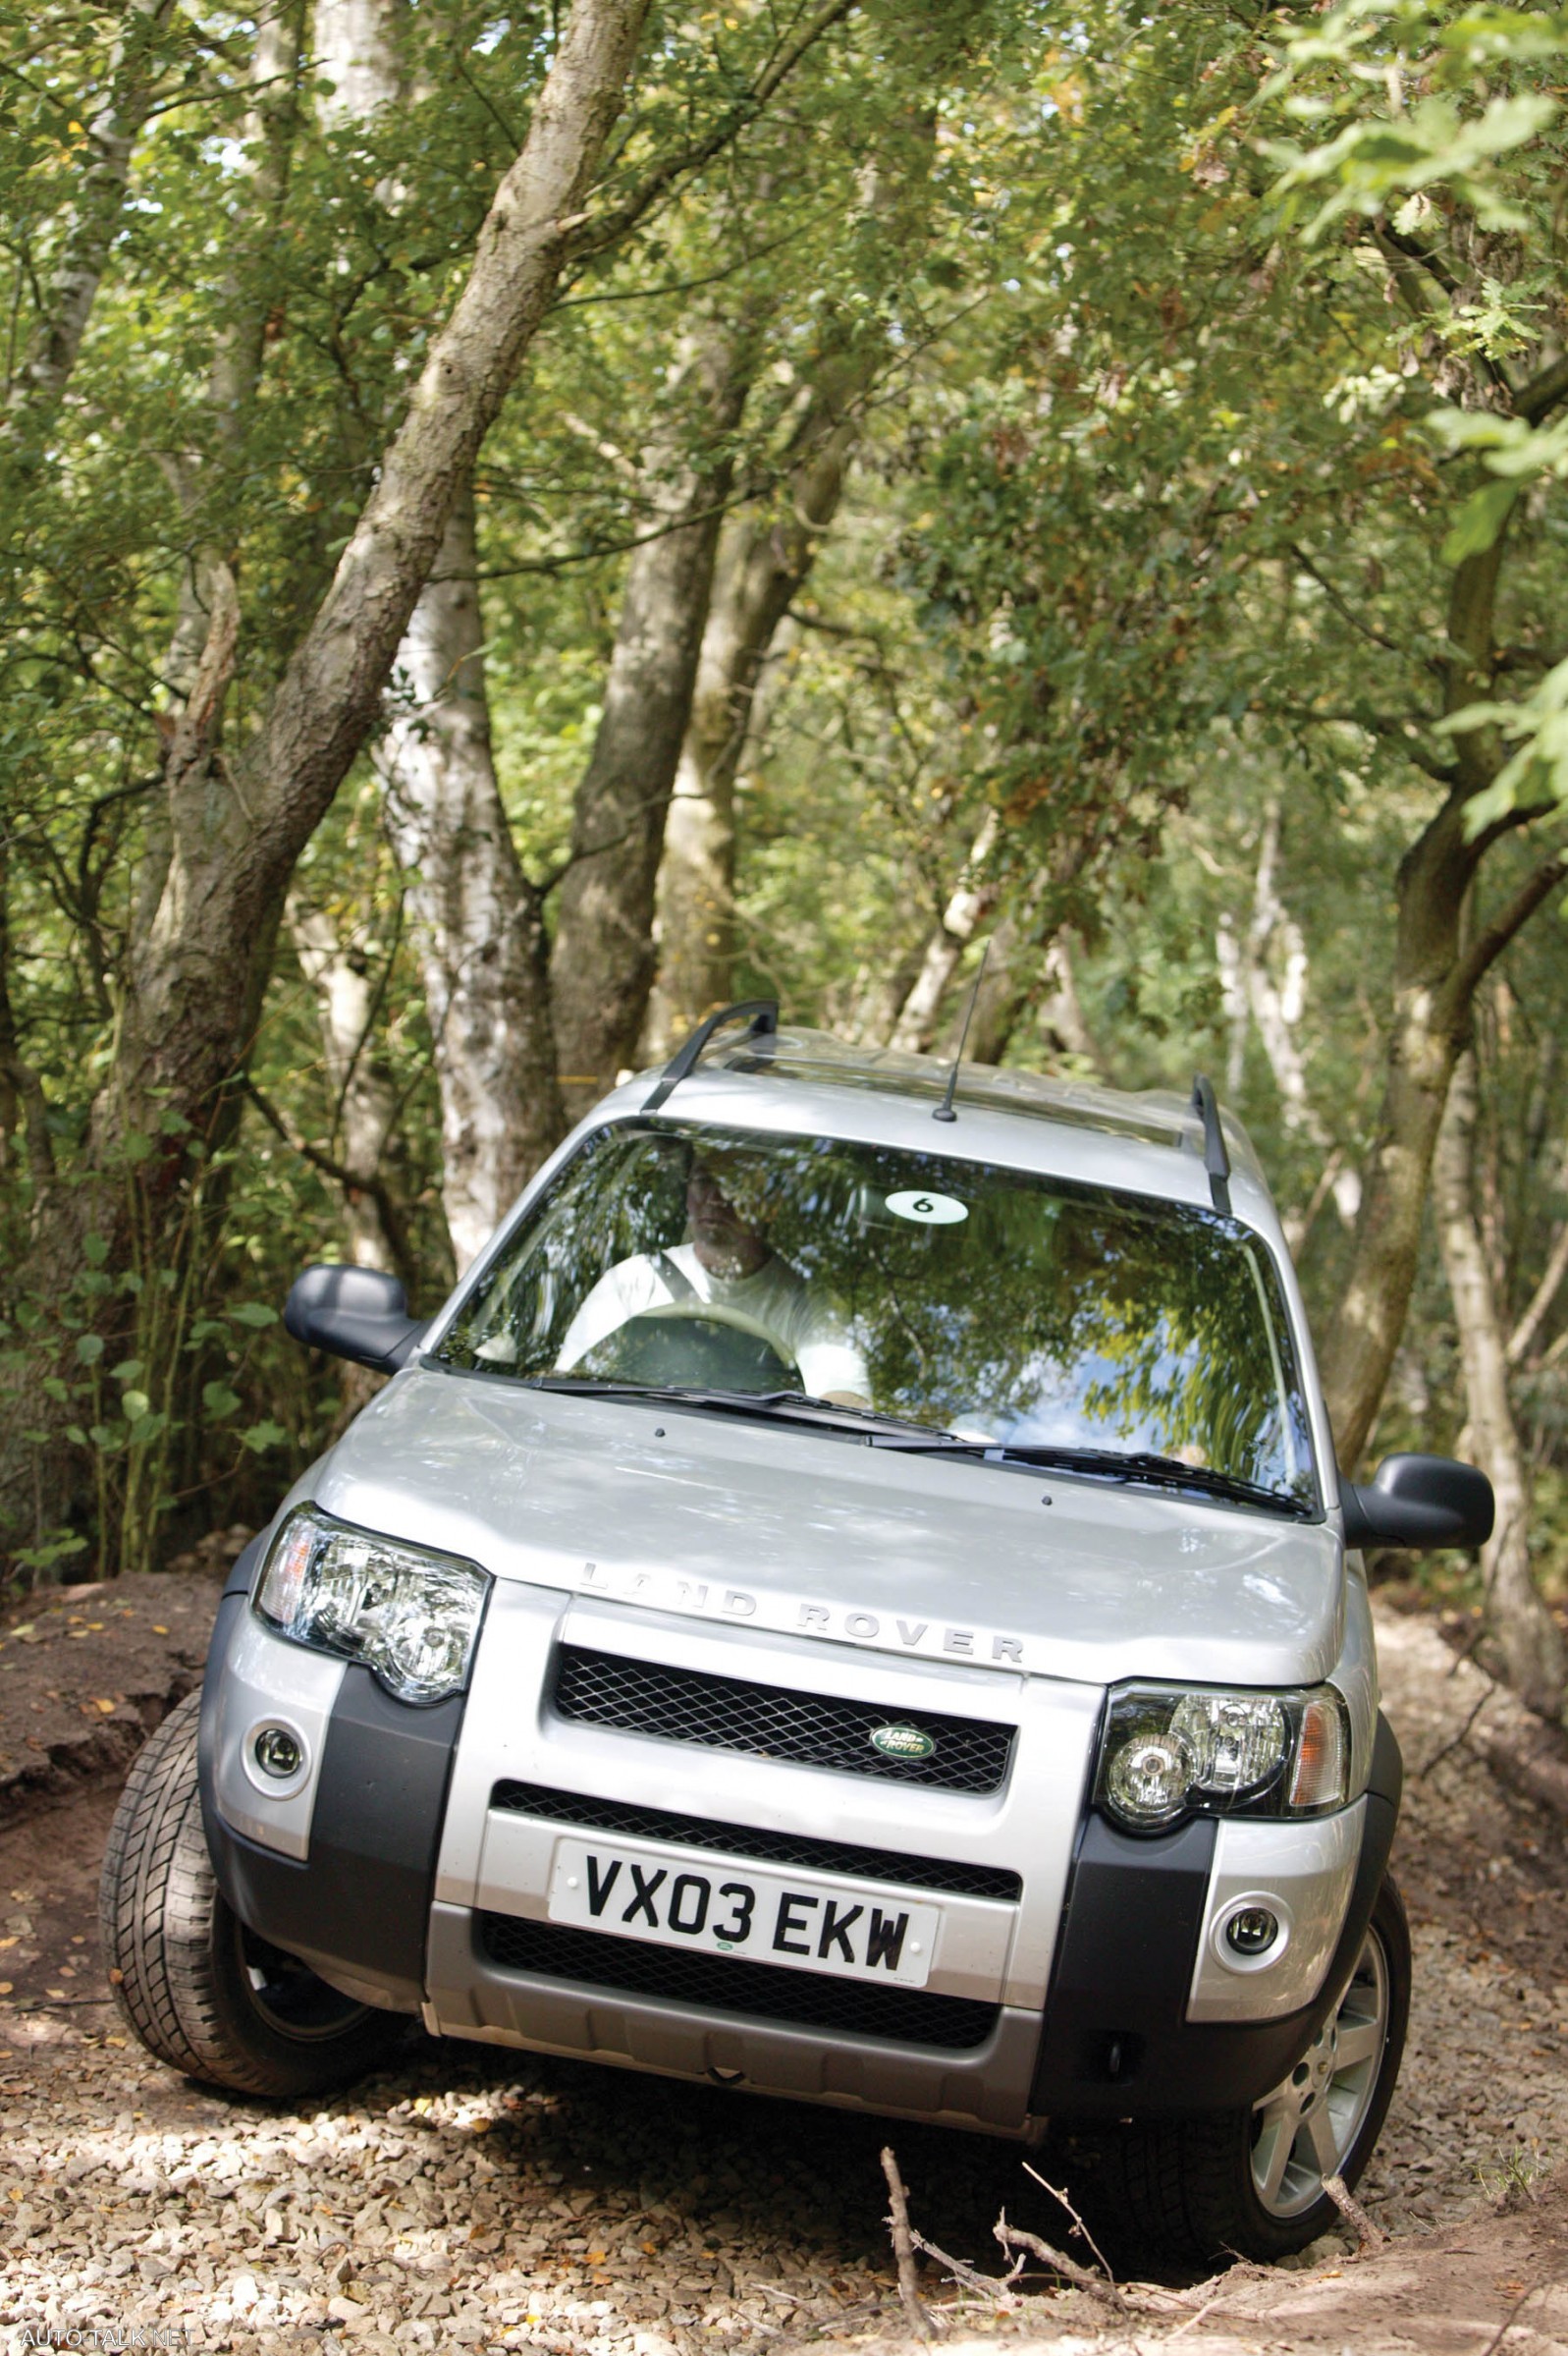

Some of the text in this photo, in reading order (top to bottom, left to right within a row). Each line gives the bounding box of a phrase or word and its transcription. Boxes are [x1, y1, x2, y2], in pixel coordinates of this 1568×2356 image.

[912, 1198, 934, 1213] 6
[578, 1562, 1025, 1664] LAND ROVER
[884, 1729, 917, 1743] LAND
[887, 1739, 925, 1754] ROVER
[586, 1854, 910, 1971] VX03 EKW
